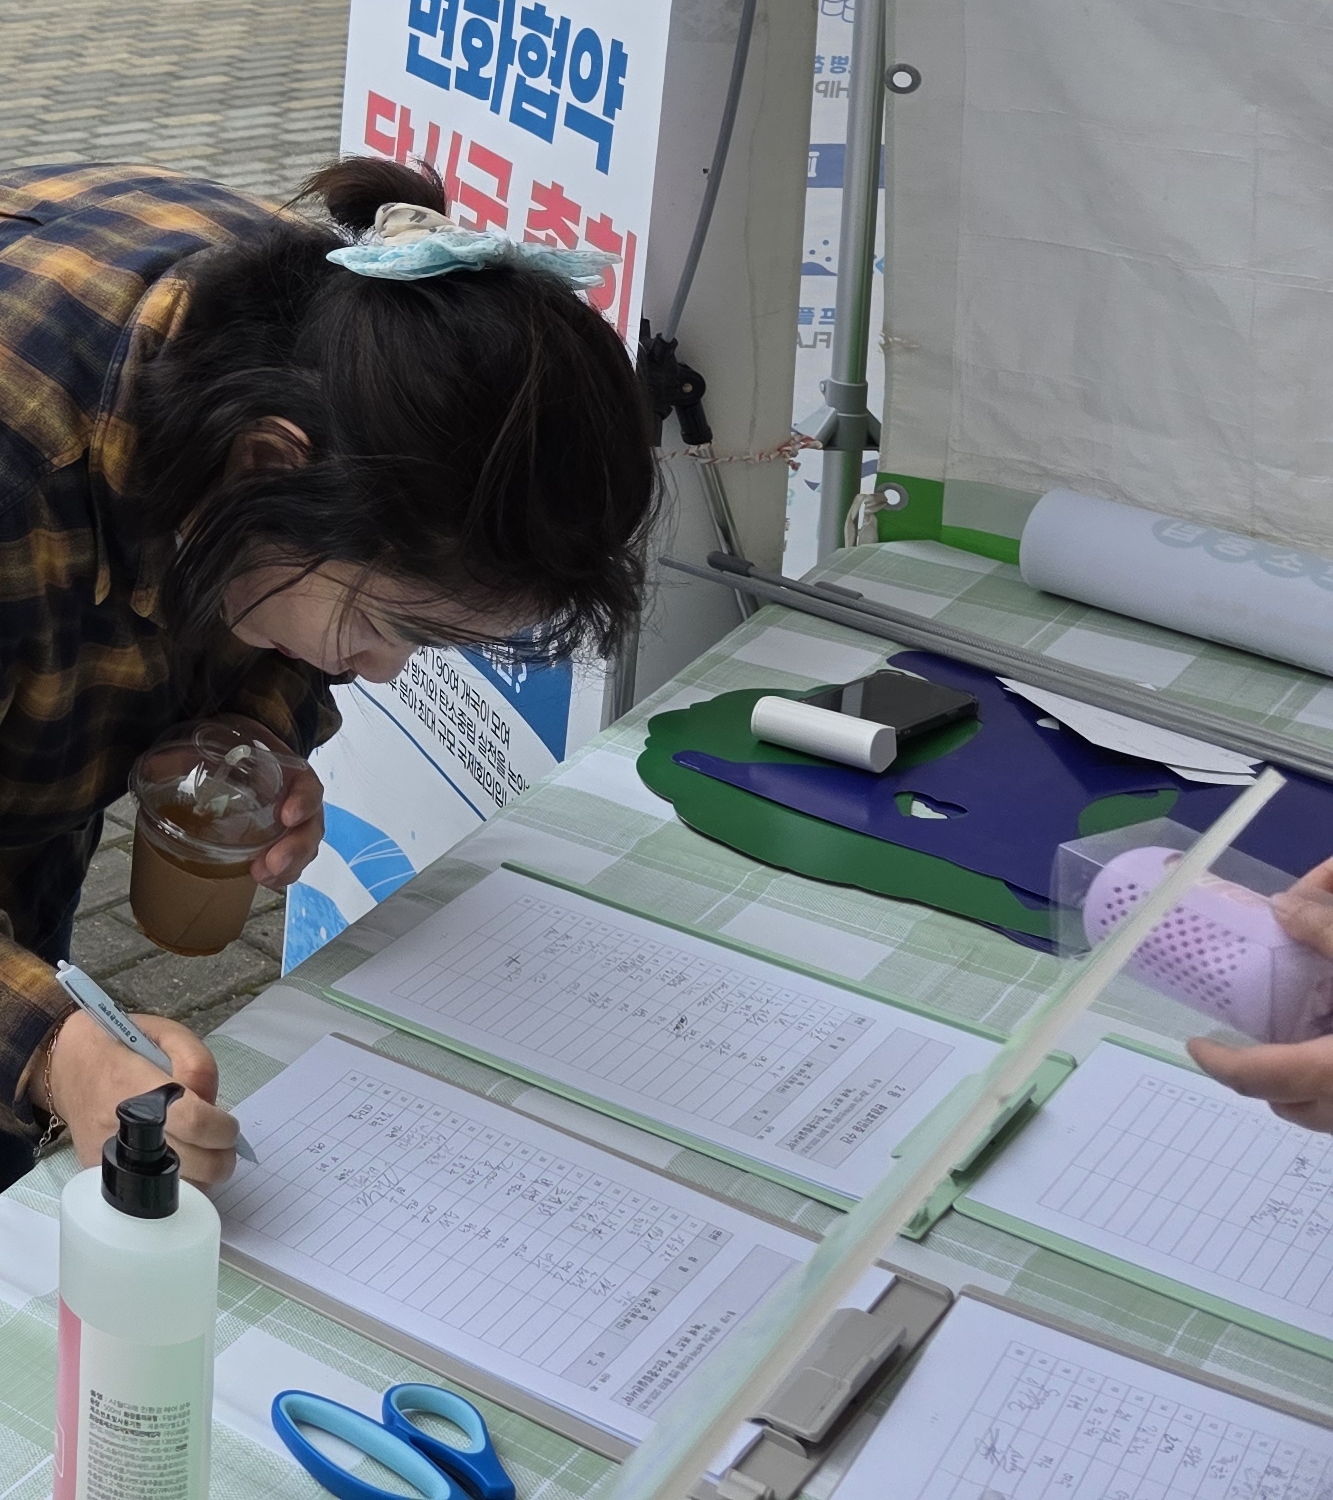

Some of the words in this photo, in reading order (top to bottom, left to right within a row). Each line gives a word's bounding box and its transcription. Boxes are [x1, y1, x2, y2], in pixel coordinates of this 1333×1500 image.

[399, 678, 417, 715] 분야
[418, 700, 436, 736] 최대
[438, 719, 456, 757] 규모
[411, 658, 438, 706] 방지와
[439, 688, 476, 746] 탄소중립
[478, 731, 506, 779] 실천을
[461, 679, 490, 729] 개국이
[490, 710, 511, 750] 모여
